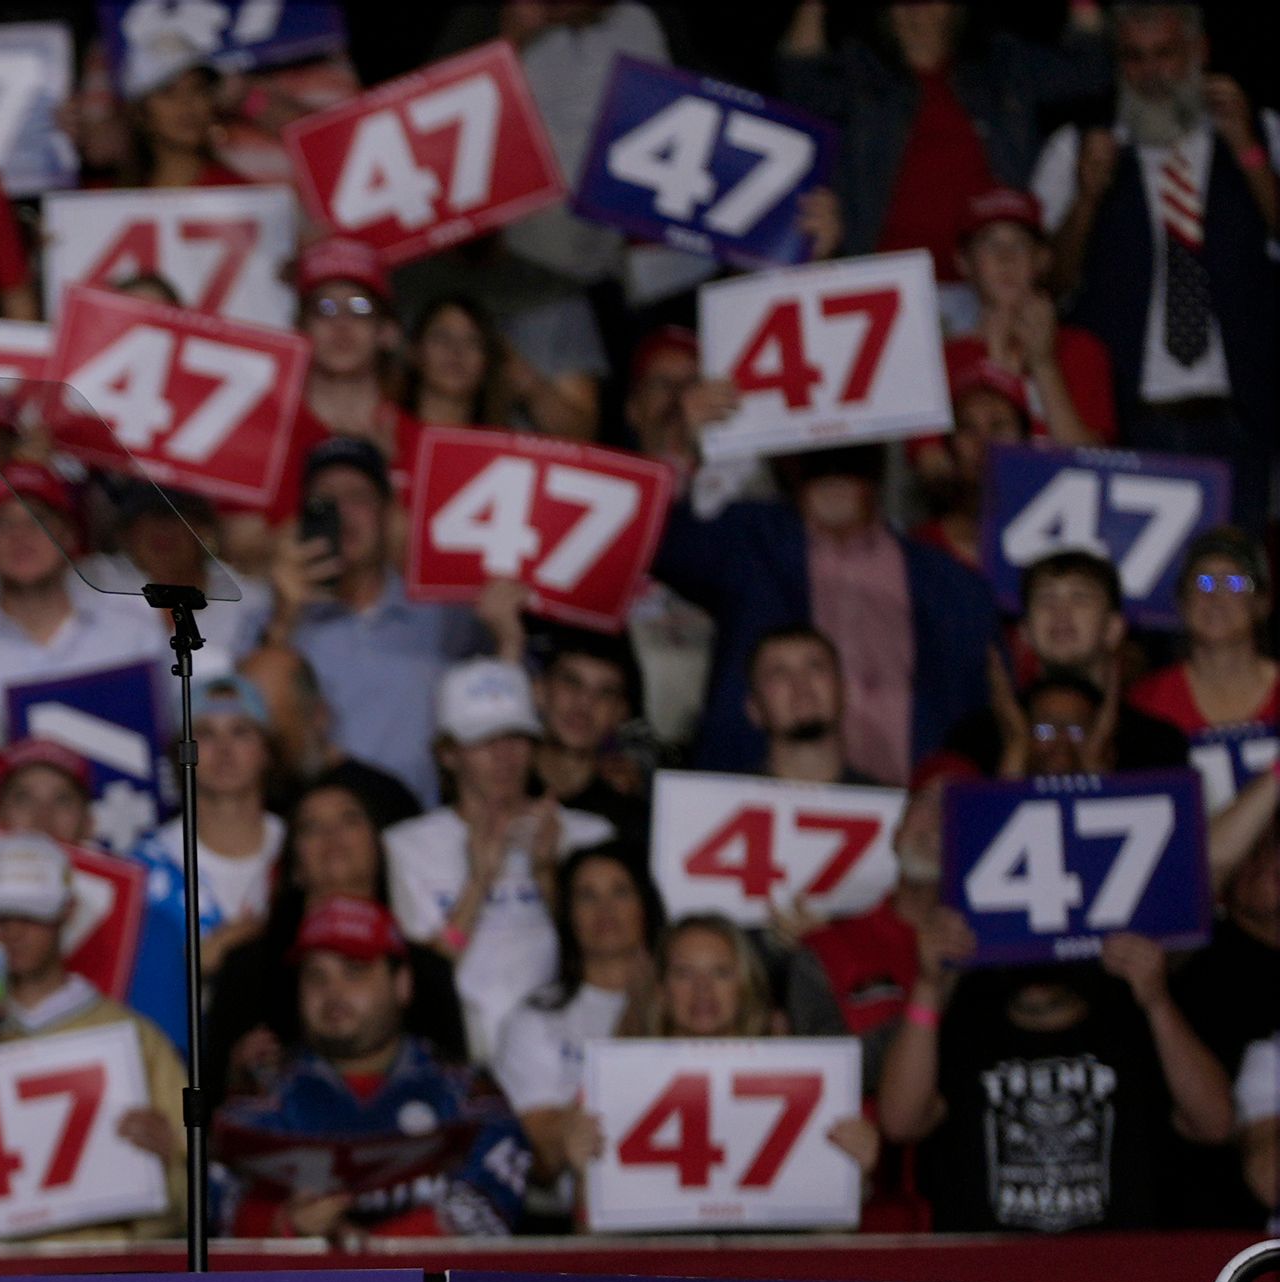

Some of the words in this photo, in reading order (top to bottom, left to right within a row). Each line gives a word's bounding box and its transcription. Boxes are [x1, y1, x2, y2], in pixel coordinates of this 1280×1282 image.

[332, 72, 499, 231] 47
[607, 95, 816, 235] 47
[84, 222, 260, 316] 47
[74, 328, 276, 463] 47
[730, 287, 902, 412] 47
[427, 455, 639, 591] 47
[1000, 469, 1202, 598] 47
[685, 806, 881, 899] 47
[964, 794, 1176, 934] 47
[618, 1070, 824, 1189] 47
